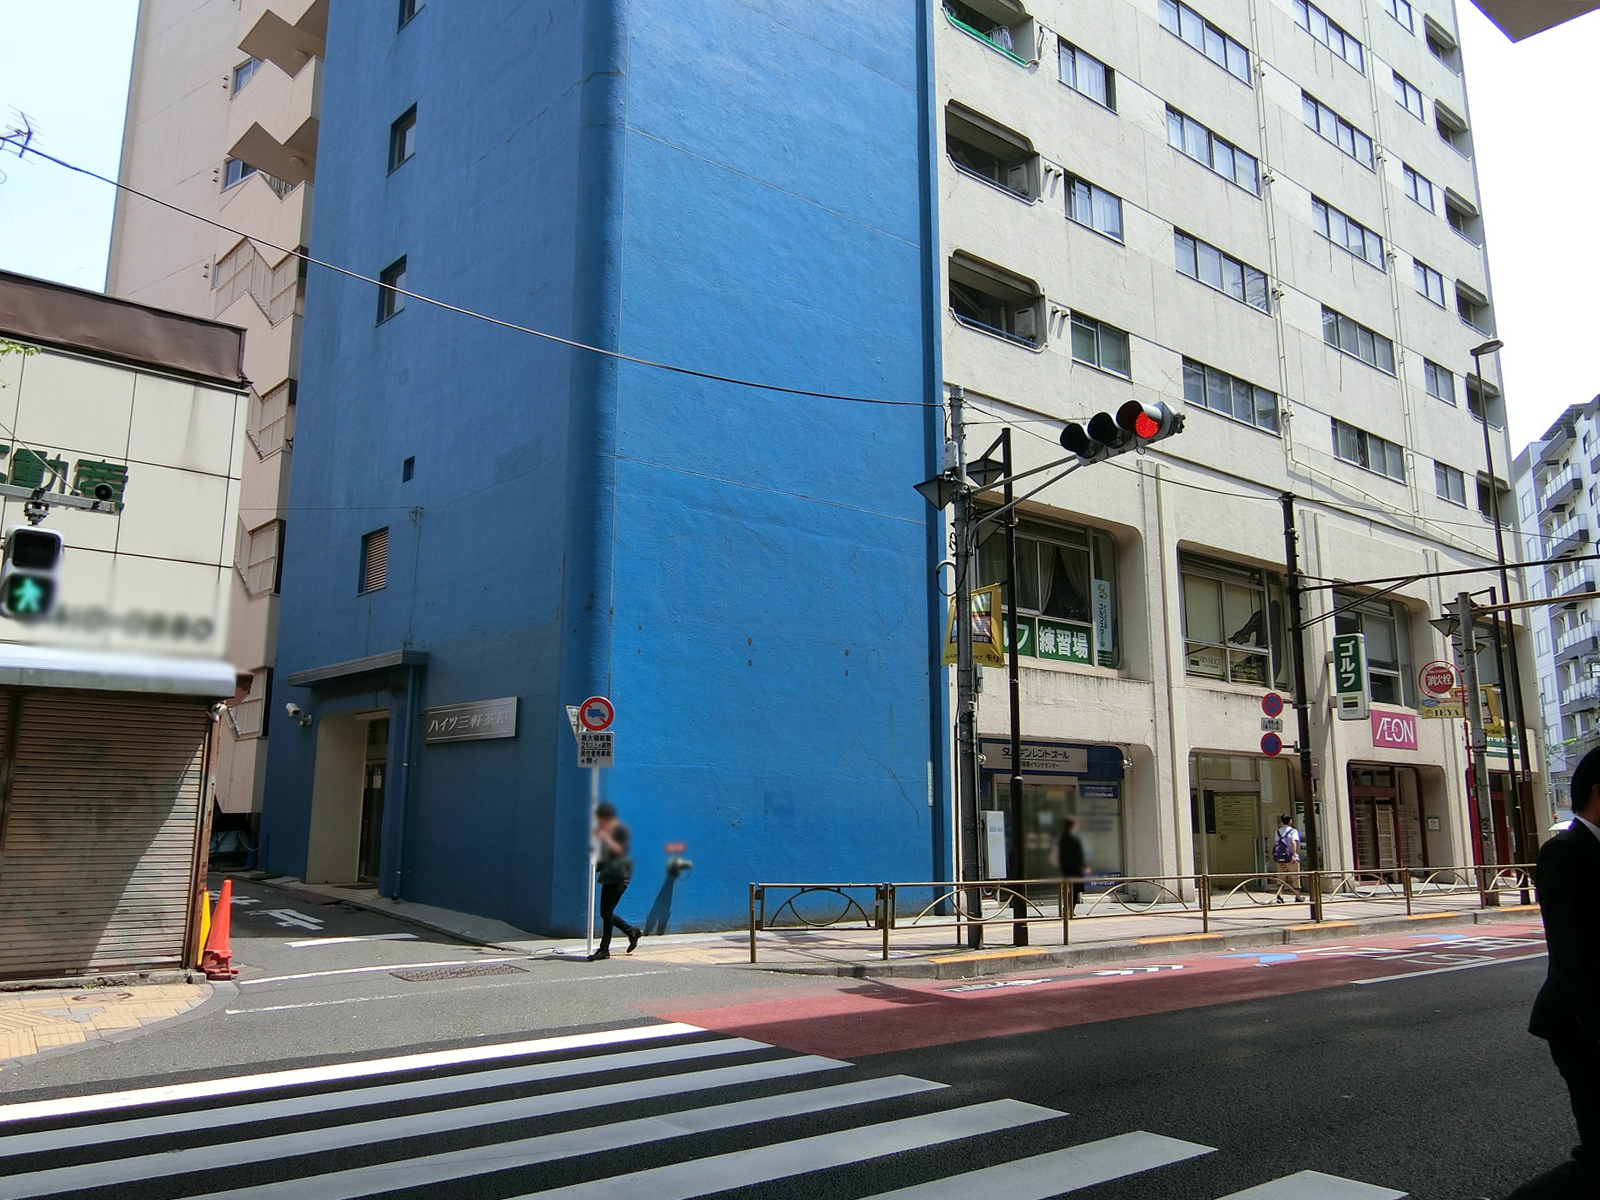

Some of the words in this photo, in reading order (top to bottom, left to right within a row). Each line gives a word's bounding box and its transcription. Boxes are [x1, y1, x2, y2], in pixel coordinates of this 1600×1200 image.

[1039, 626, 1089, 659] 練習場
[1339, 640, 1356, 688] ゴルフ
[1427, 673, 1453, 687] 消火栓
[428, 711, 510, 733] ハイツ三軒茶屋
